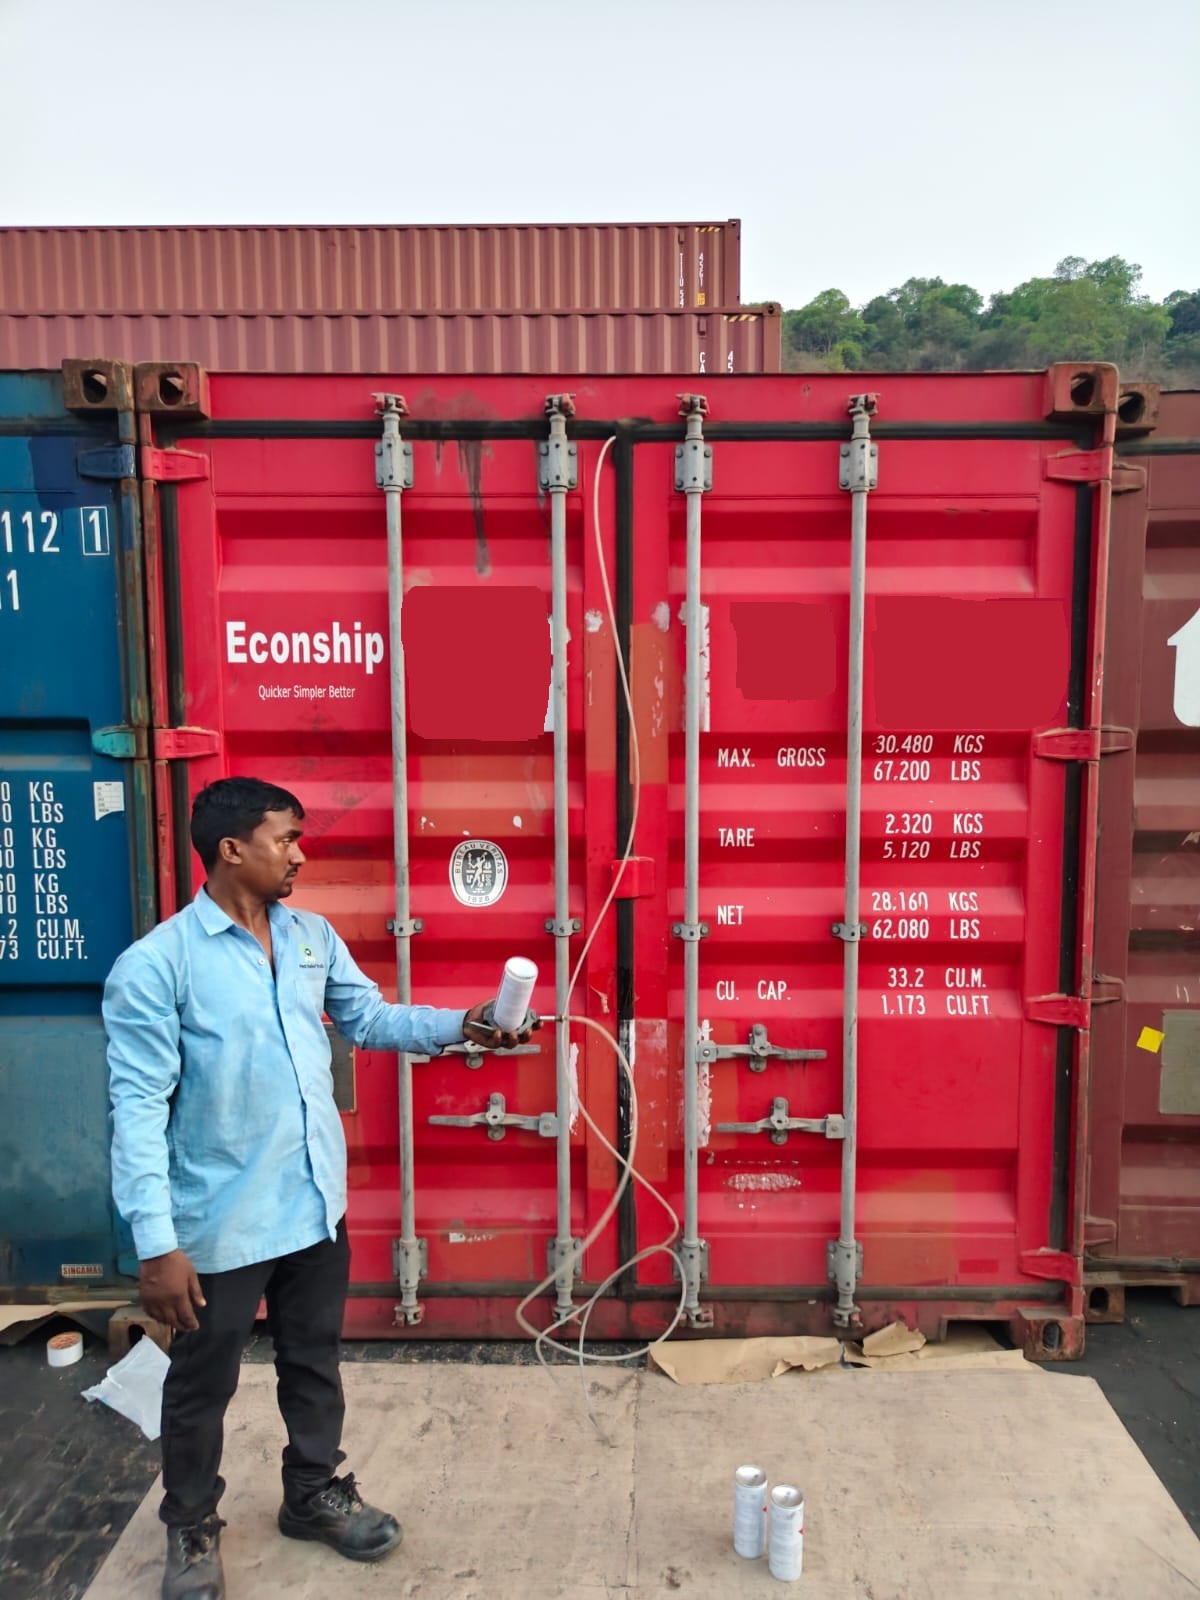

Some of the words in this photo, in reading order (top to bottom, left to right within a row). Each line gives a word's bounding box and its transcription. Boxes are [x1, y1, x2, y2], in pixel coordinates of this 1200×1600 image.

[0, 569, 20, 611] 1
[225, 621, 385, 675] Econship
[258, 685, 292, 700] Quicker
[293, 685, 327, 700] Simpler
[328, 685, 356, 699] Better
[953, 734, 985, 754] KGS
[717, 748, 756, 768] MAX.
[776, 747, 826, 767] GROSS
[951, 760, 981, 781] LBS
[29, 781, 54, 802] KG
[31, 803, 64, 823] LBS
[953, 813, 984, 834] KGS
[32, 827, 57, 848] KG
[718, 828, 755, 847] TARE
[33, 849, 67, 869] LBS
[949, 841, 982, 858] LBS
[34, 873, 59, 894] KG
[35, 894, 68, 914] LBS
[948, 891, 979, 911] KGS
[717, 905, 744, 925] NET
[36, 918, 85, 939] CU.M.
[950, 918, 980, 939] LBS
[37, 939, 88, 960] CU.FT.
[888, 967, 925, 988] 33.2
[945, 967, 986, 988] CU.M.
[716, 980, 740, 1001] CU.
[757, 980, 792, 1001] CAP.
